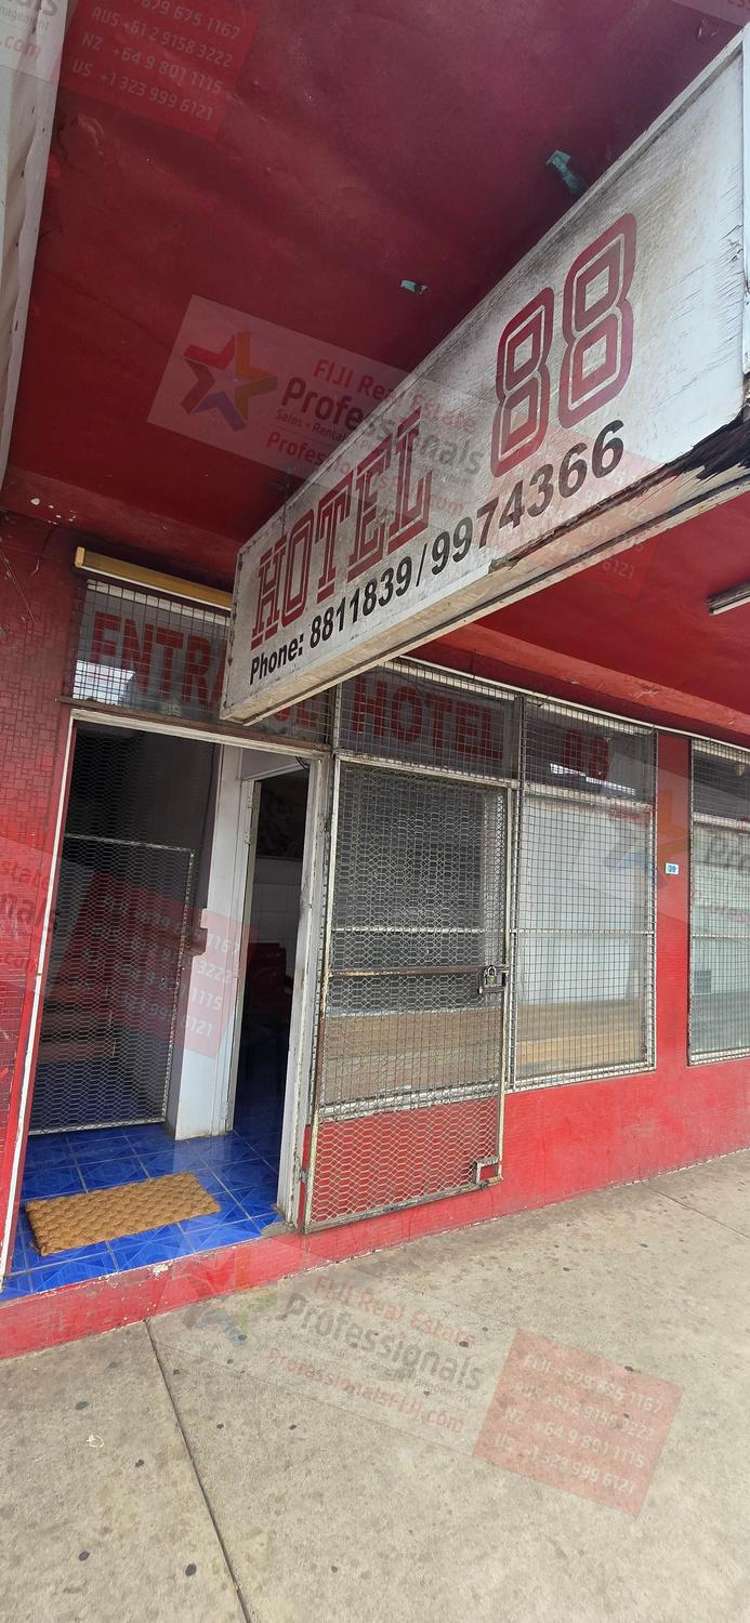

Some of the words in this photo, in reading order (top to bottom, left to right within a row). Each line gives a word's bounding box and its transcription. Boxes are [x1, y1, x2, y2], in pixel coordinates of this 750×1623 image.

[490, 212, 638, 478] 88
[250, 405, 433, 652] HOTEL
[250, 633, 304, 685] Phone:
[351, 676, 503, 761] HOTEL
